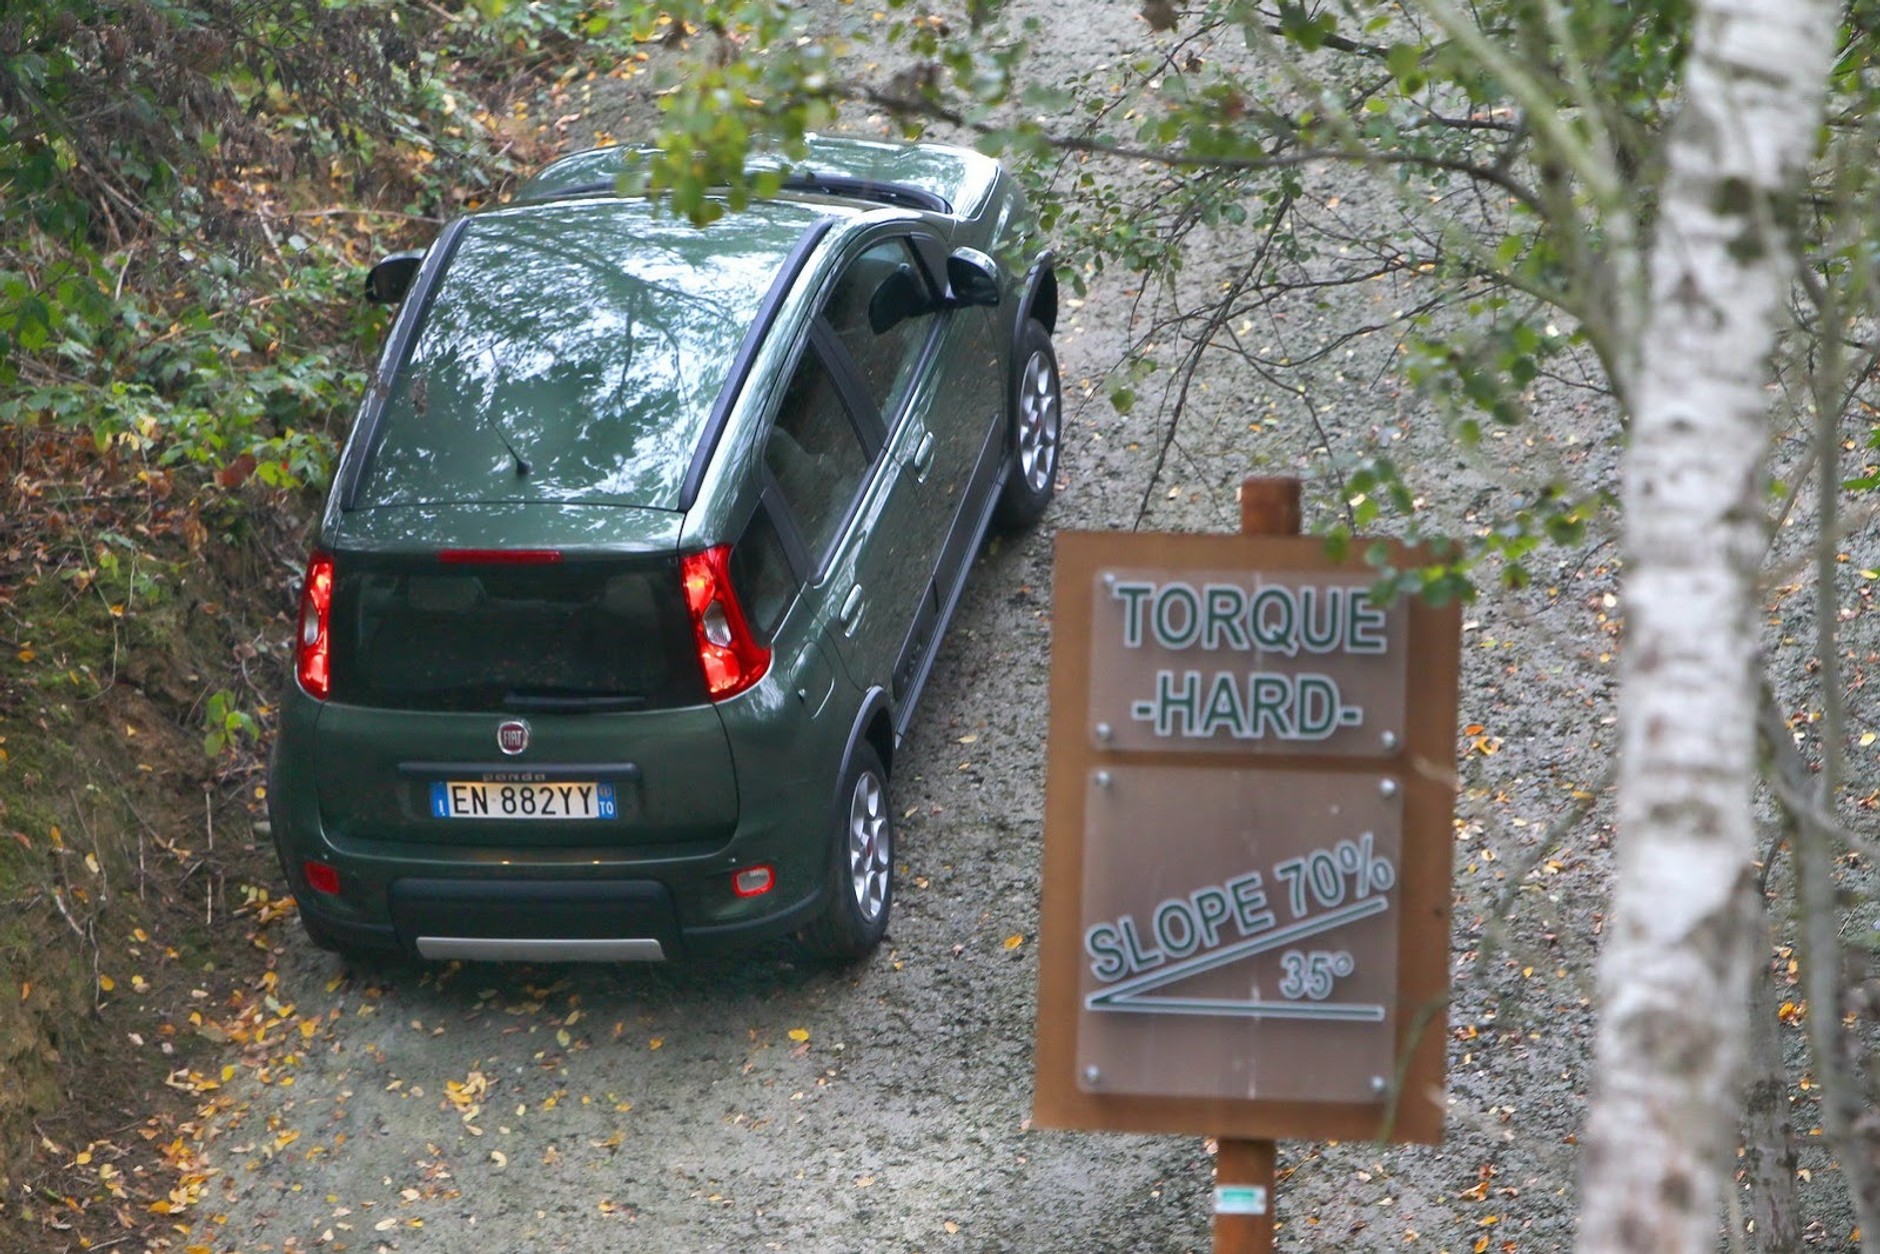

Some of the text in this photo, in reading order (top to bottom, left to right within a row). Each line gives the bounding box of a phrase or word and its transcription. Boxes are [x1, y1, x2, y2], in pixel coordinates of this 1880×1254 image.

[1113, 582, 1387, 656] TORQUE
[503, 730, 522, 746] FIAT
[1131, 670, 1363, 739] -HARD-
[1085, 831, 1395, 982] SLOPE 70%
[1279, 950, 1354, 999] 35°
